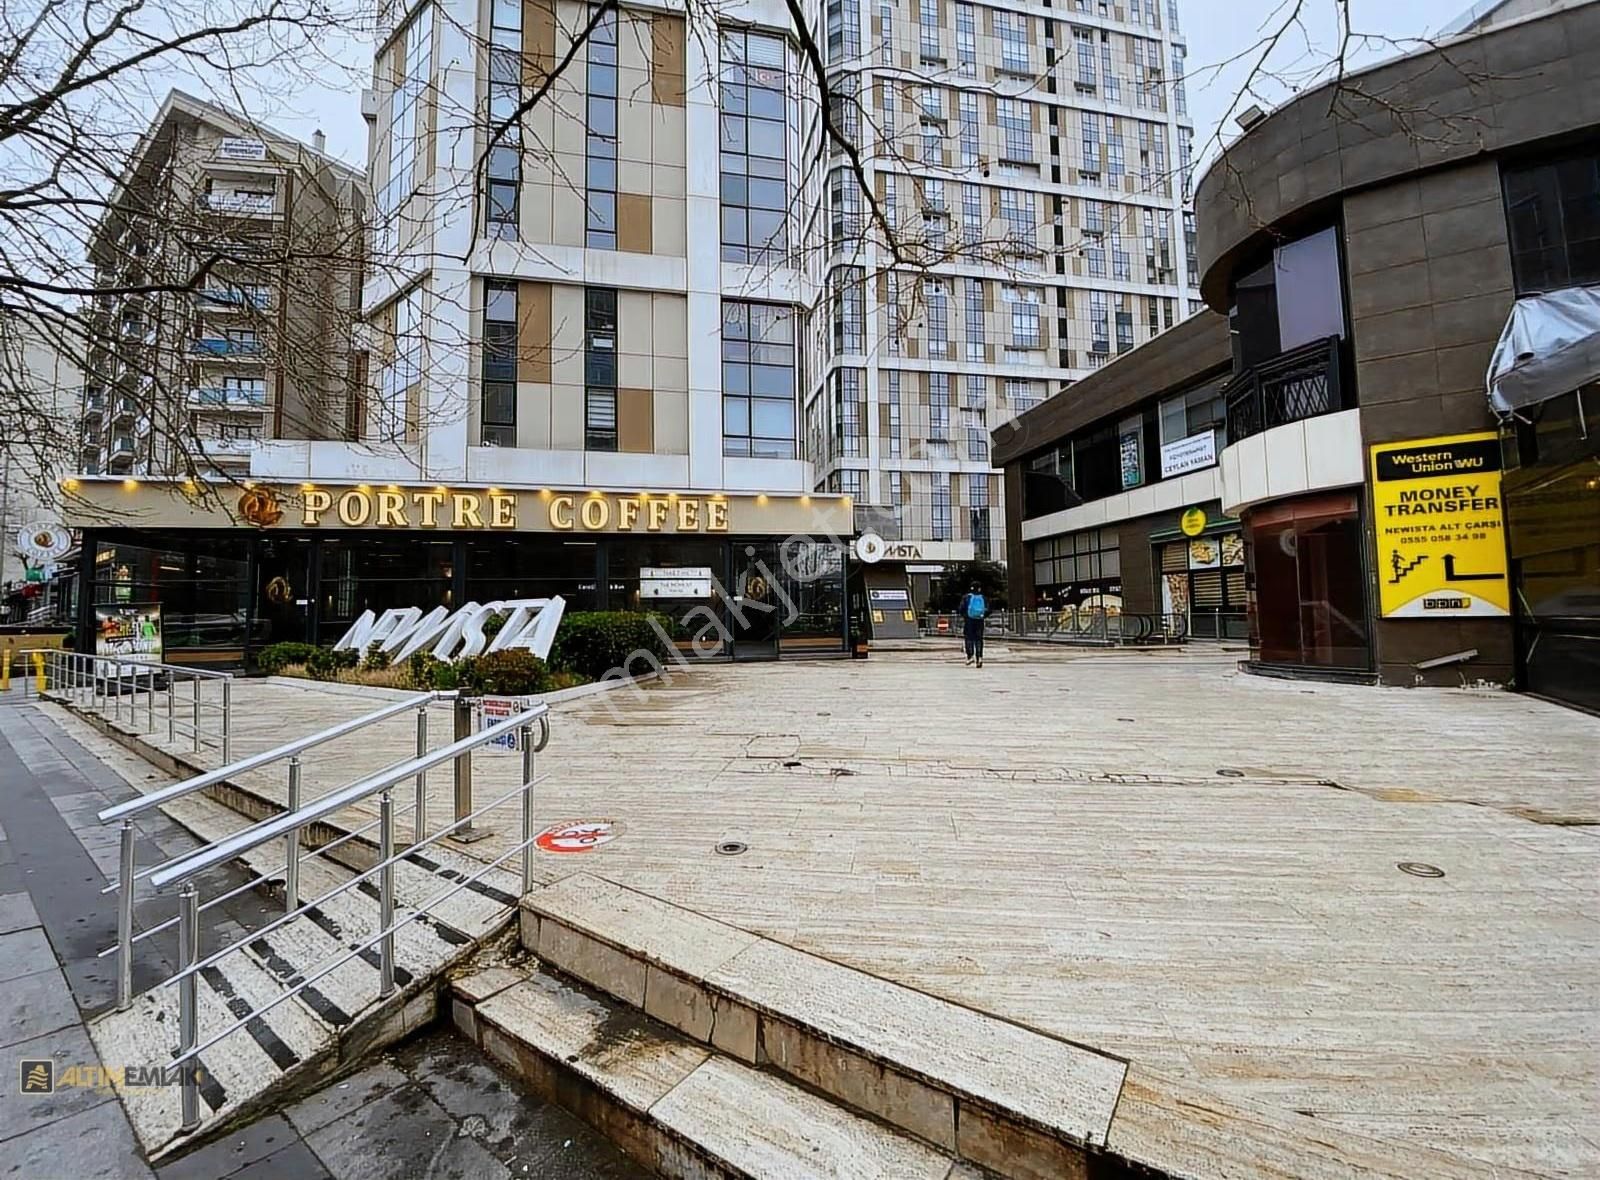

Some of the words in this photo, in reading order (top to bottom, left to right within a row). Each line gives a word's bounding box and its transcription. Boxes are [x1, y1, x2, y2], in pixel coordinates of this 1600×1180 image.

[1392, 452, 1452, 465] Western
[1411, 461, 1453, 473] Union
[1400, 485, 1480, 503] MONEY
[302, 490, 516, 529] PORTRE
[549, 496, 729, 531] COFFEE
[1384, 497, 1499, 517] TRANSFER
[1385, 525, 1436, 535] NEWISTA
[1440, 523, 1461, 531] ALT
[1455, 533, 1469, 541] 34
